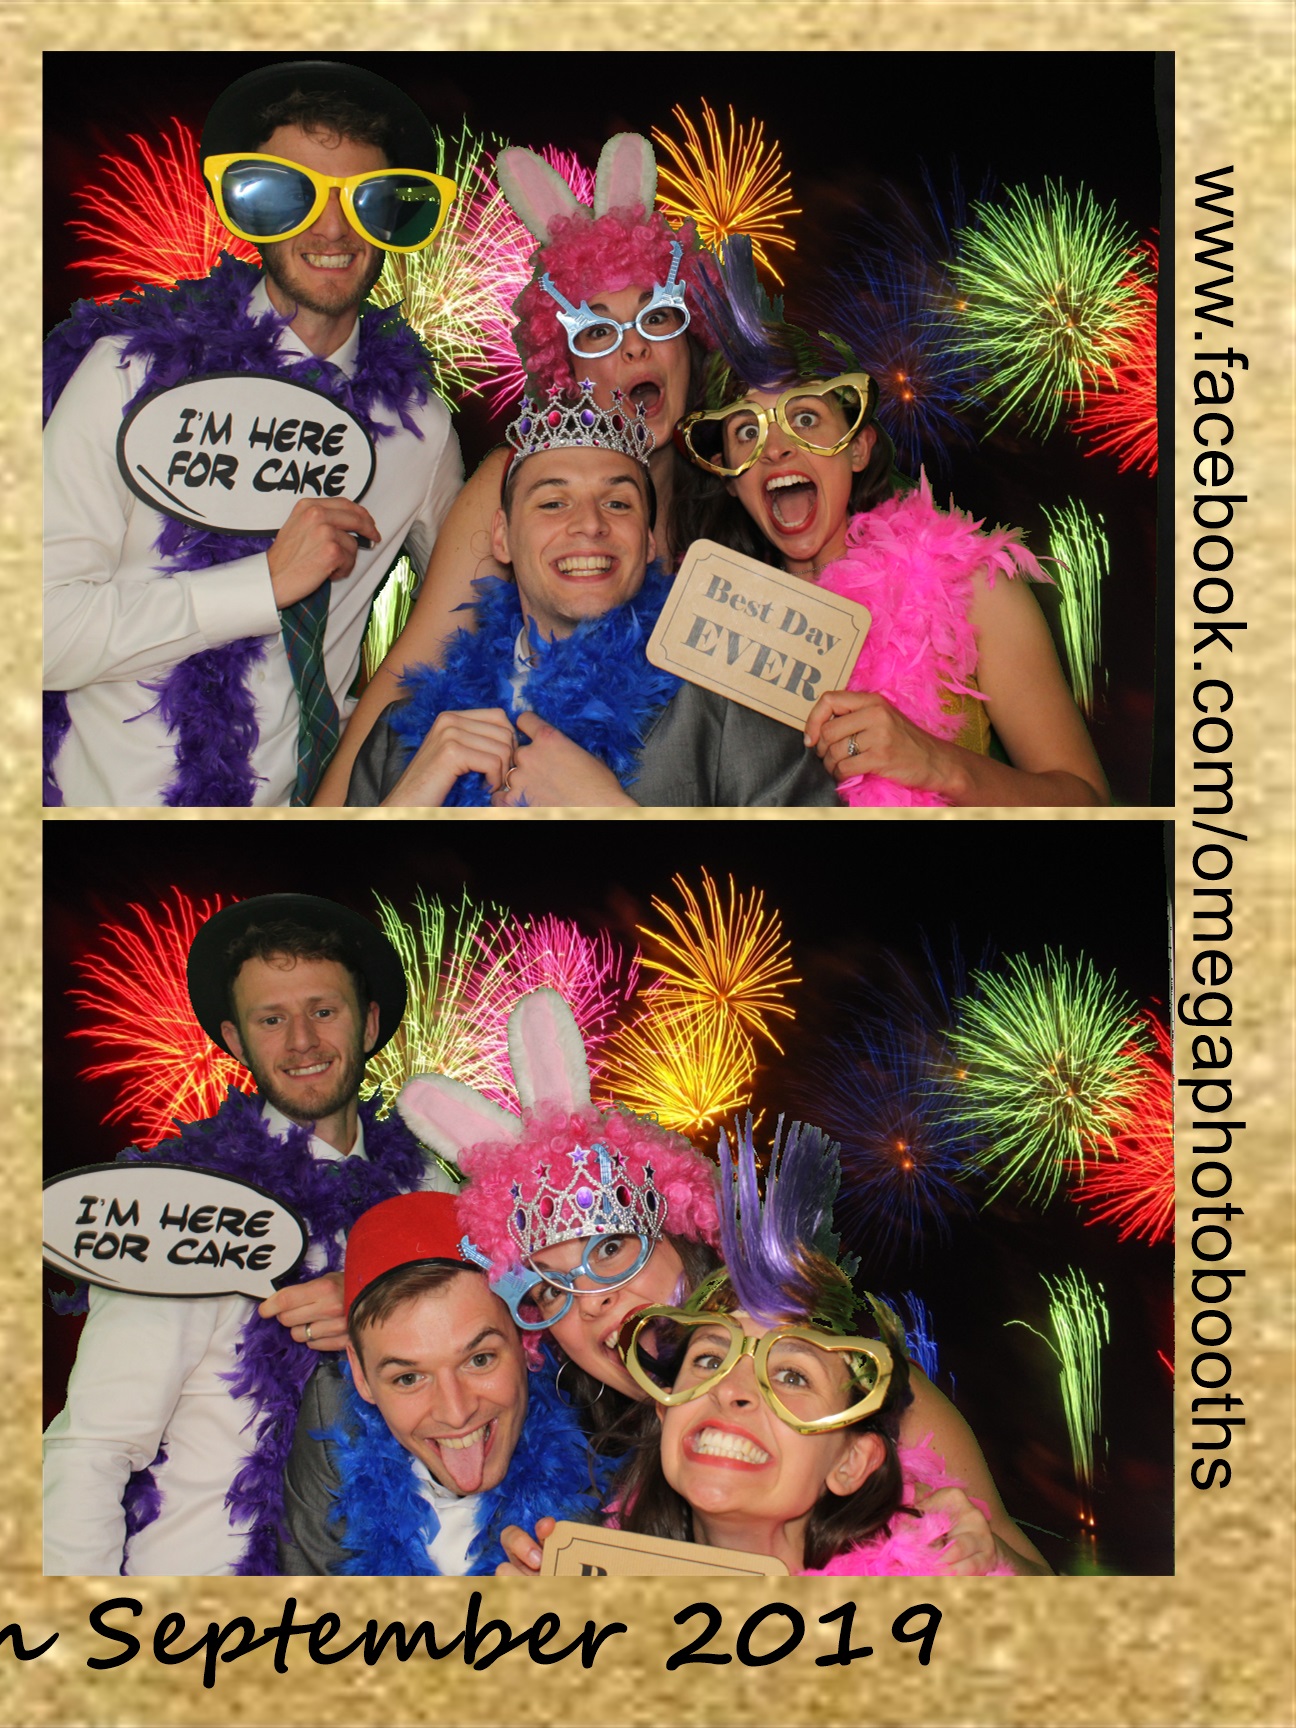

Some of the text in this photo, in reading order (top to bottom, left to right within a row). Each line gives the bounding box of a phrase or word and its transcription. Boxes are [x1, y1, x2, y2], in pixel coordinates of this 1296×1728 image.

[172, 408, 348, 457] I'M HERE
[167, 450, 349, 497] FOR CAKE
[702, 573, 843, 656] Best Day
[680, 613, 822, 702] EVER
[75, 1195, 275, 1238] I'M HERE
[74, 1230, 276, 1271] FOR CAKE
